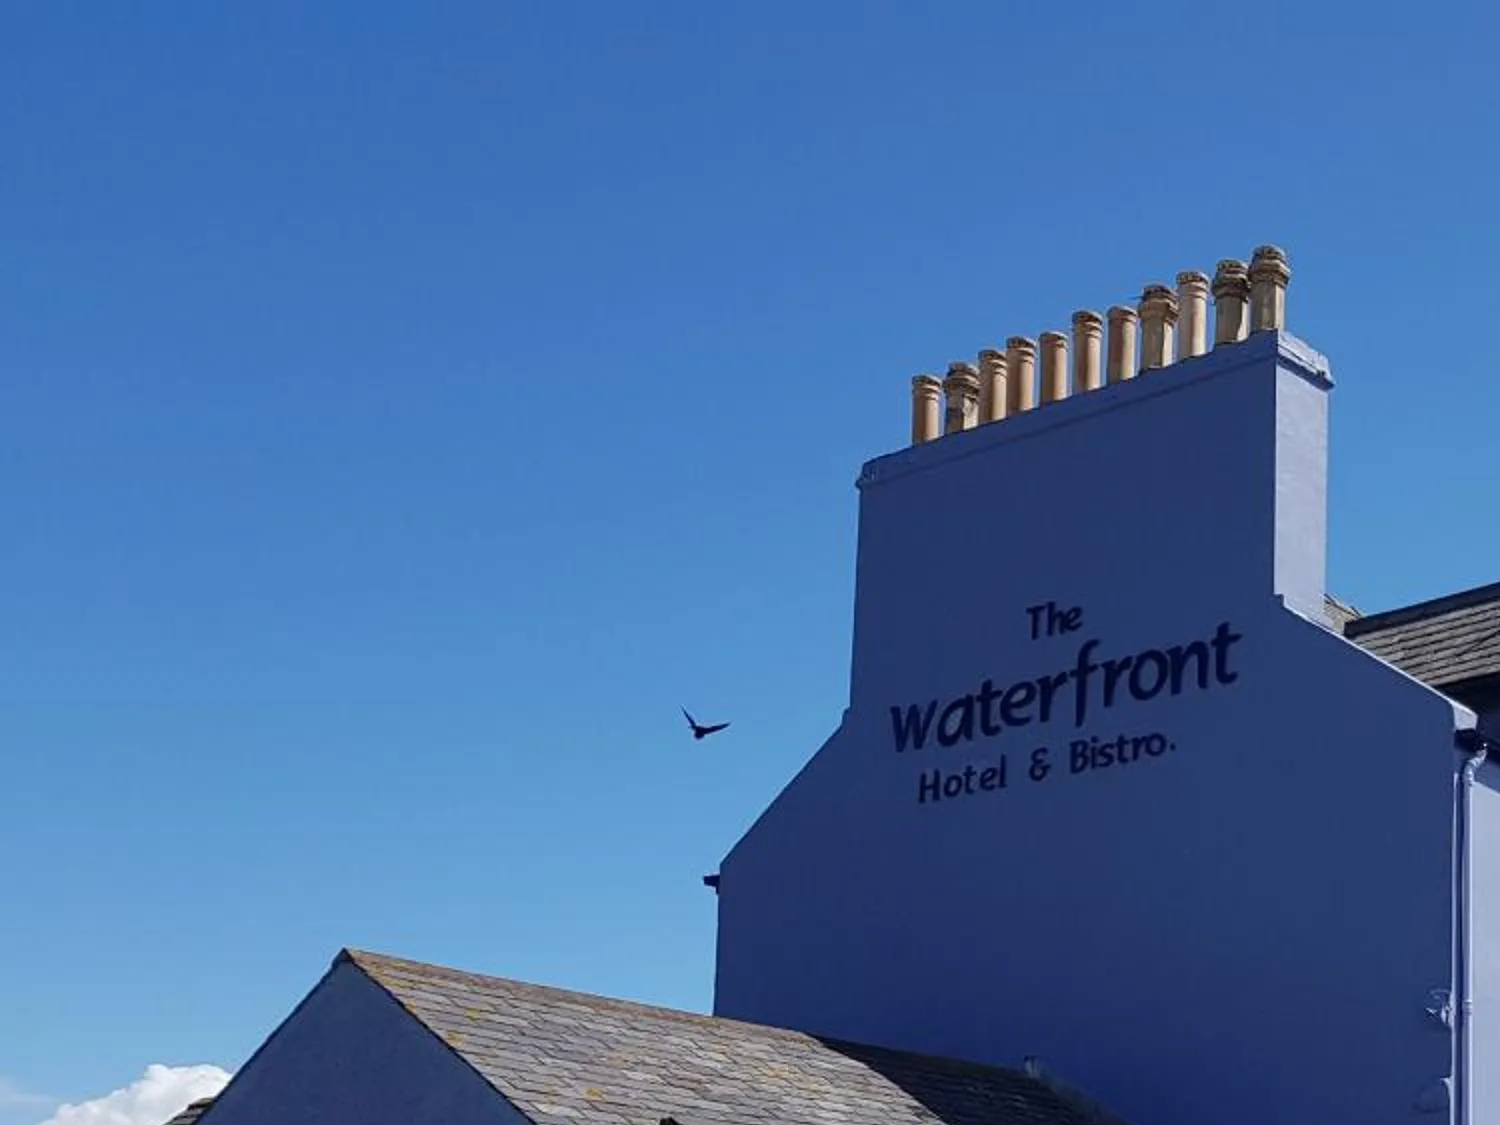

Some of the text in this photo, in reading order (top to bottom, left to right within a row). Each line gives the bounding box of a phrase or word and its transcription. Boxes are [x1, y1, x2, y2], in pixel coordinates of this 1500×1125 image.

[1026, 602, 1083, 640] The
[918, 754, 1007, 803] Hotel
[1028, 747, 1051, 782] &
